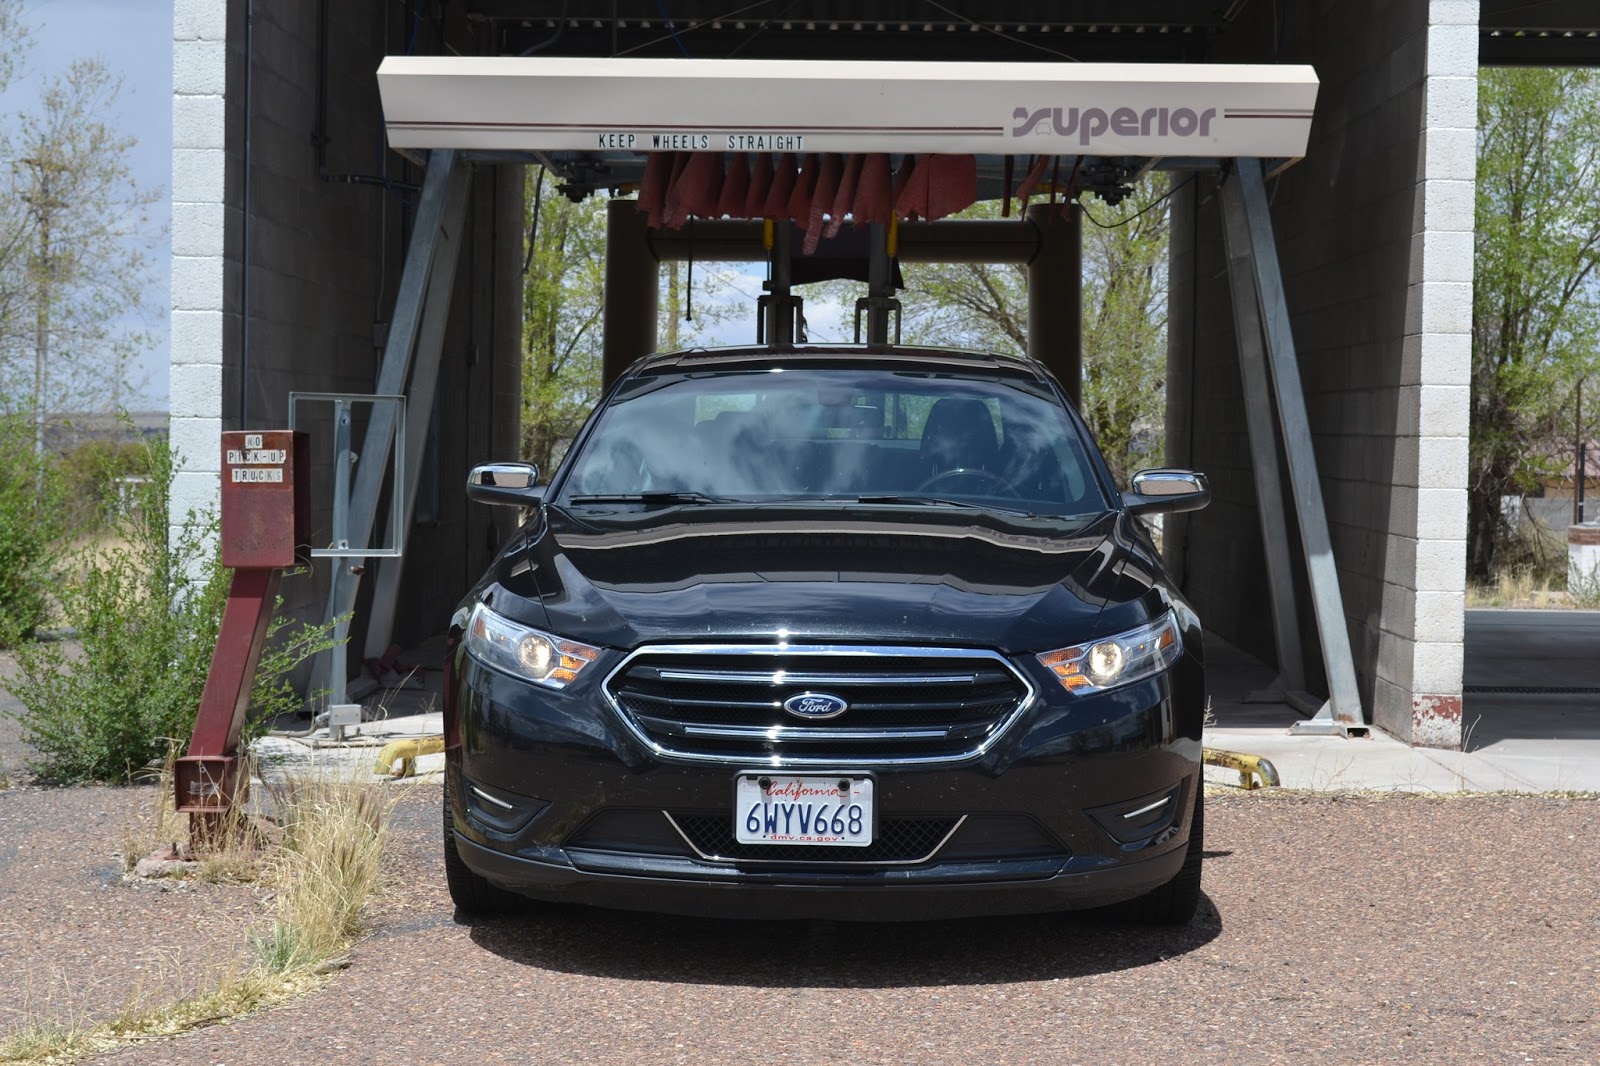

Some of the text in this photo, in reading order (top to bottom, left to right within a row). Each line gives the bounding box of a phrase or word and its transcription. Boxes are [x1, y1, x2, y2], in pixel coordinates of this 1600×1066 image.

[598, 134, 803, 150] KEEP WHEELS STRAIGHT
[246, 436, 261, 447] NO
[228, 451, 285, 462] PICK-UP
[233, 470, 281, 481] TRUCKS
[798, 698, 833, 713] Ford
[766, 780, 848, 801] California
[746, 802, 863, 835] 6WYV668
[770, 834, 838, 842] dmv.ca.gov
